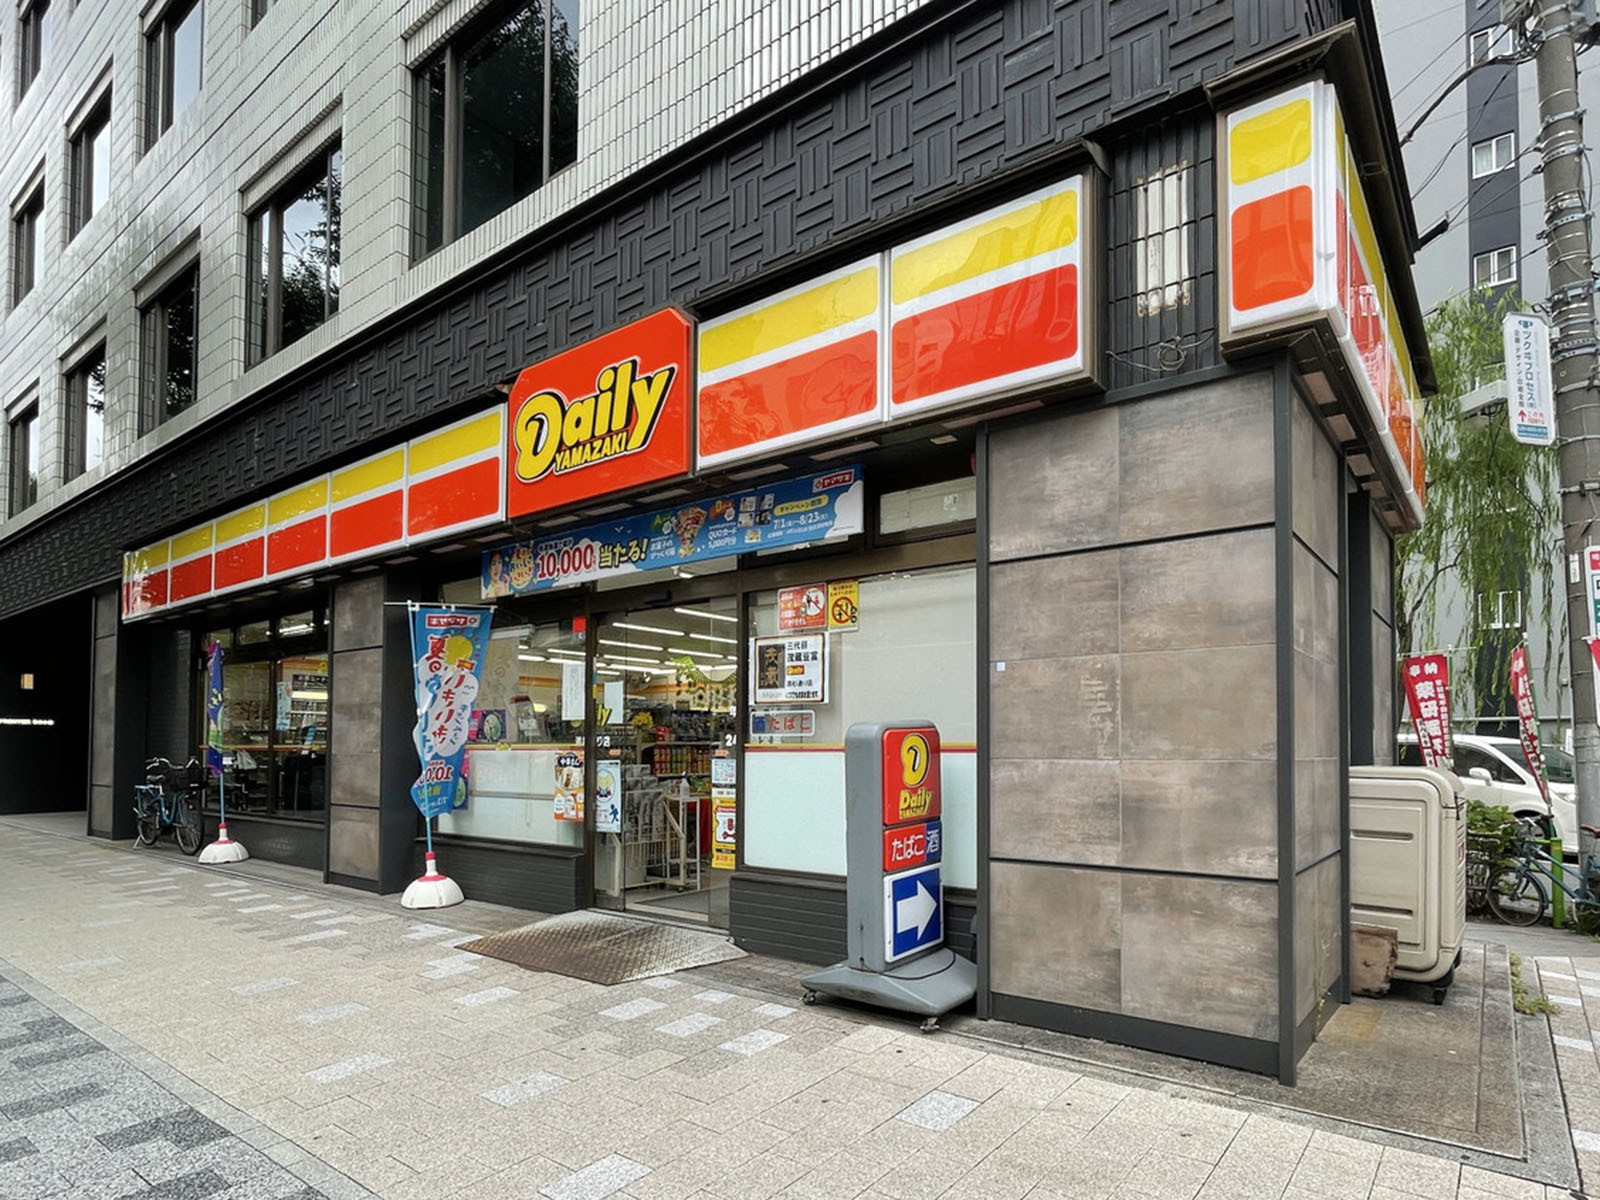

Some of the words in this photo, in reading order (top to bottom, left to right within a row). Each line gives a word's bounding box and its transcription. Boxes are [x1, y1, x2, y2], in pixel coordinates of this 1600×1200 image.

[514, 359, 676, 481] Daily
[554, 431, 629, 471] YAMAZAKI
[537, 543, 595, 580] 10,000
[767, 715, 811, 731] たばこ
[899, 787, 932, 816] Daily
[891, 833, 924, 862] たばこ
[926, 829, 939, 853] 酒
